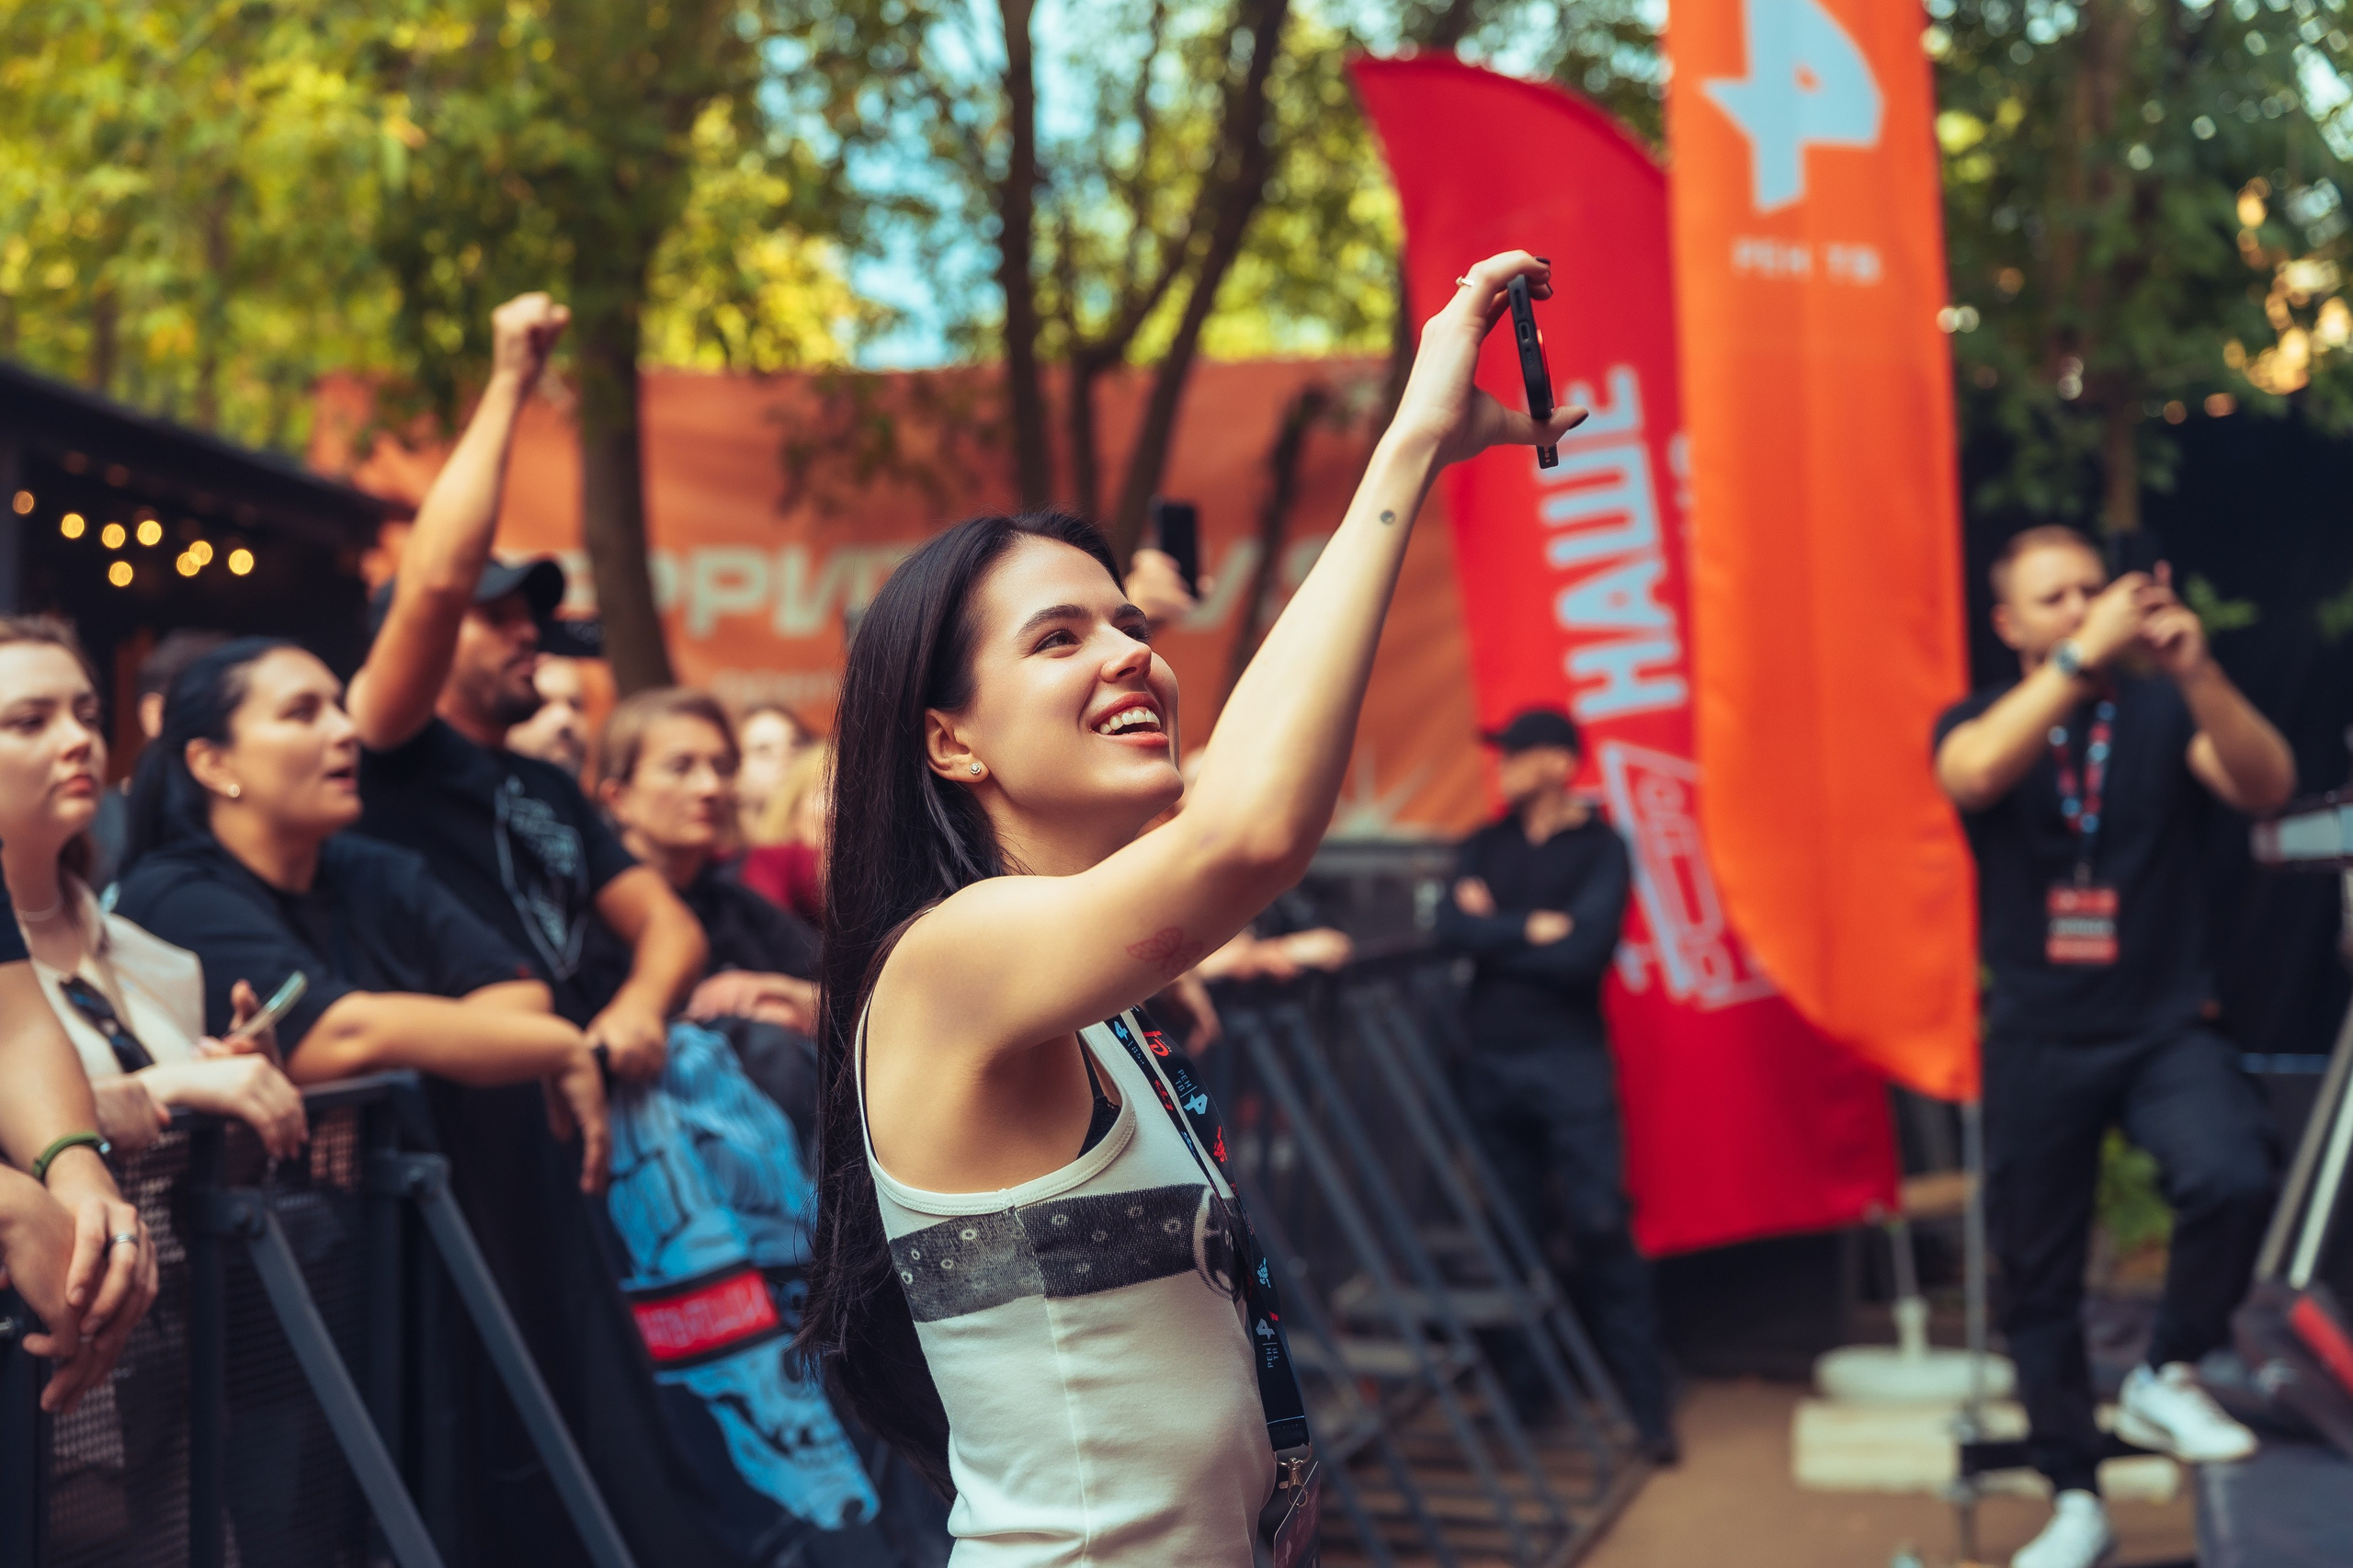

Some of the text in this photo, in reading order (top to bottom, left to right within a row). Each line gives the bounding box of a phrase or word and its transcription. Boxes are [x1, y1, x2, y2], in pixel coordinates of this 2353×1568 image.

[1521, 366, 1688, 719] НАШЕ
[1175, 1079, 1186, 1093] ТВ
[1177, 1069, 1192, 1088] РЕН
